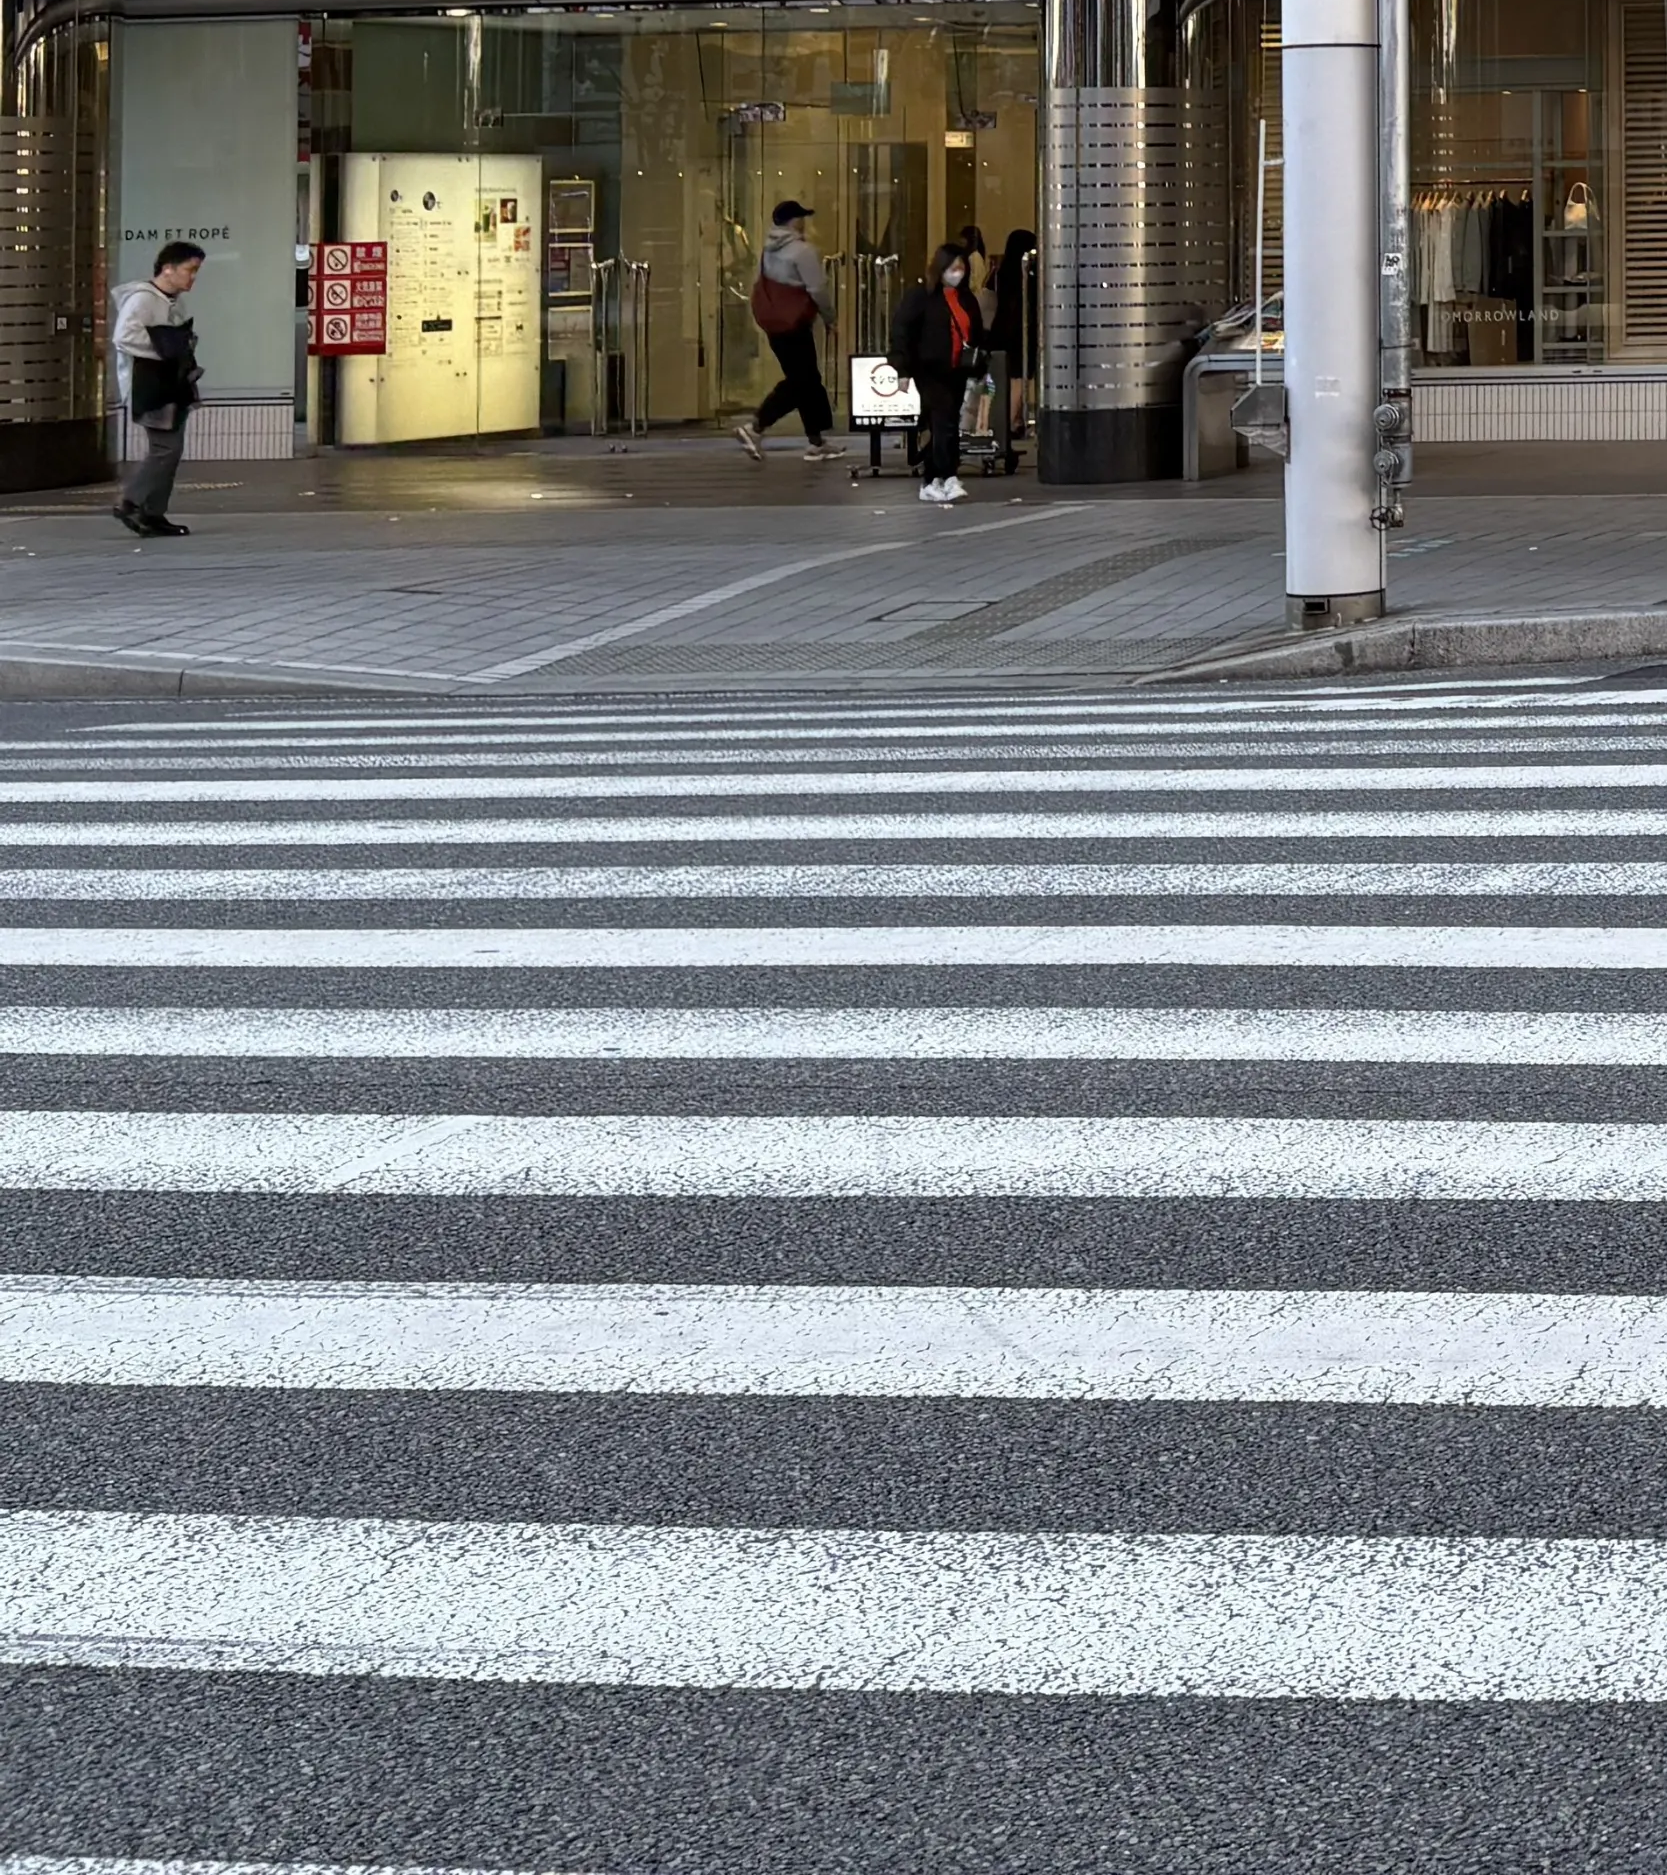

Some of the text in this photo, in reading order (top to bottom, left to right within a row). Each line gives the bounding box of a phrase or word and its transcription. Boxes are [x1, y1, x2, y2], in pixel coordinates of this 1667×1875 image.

[123, 225, 230, 241] DAM ET ROPÉ
[1438, 308, 1560, 323] OMORROWLAND
